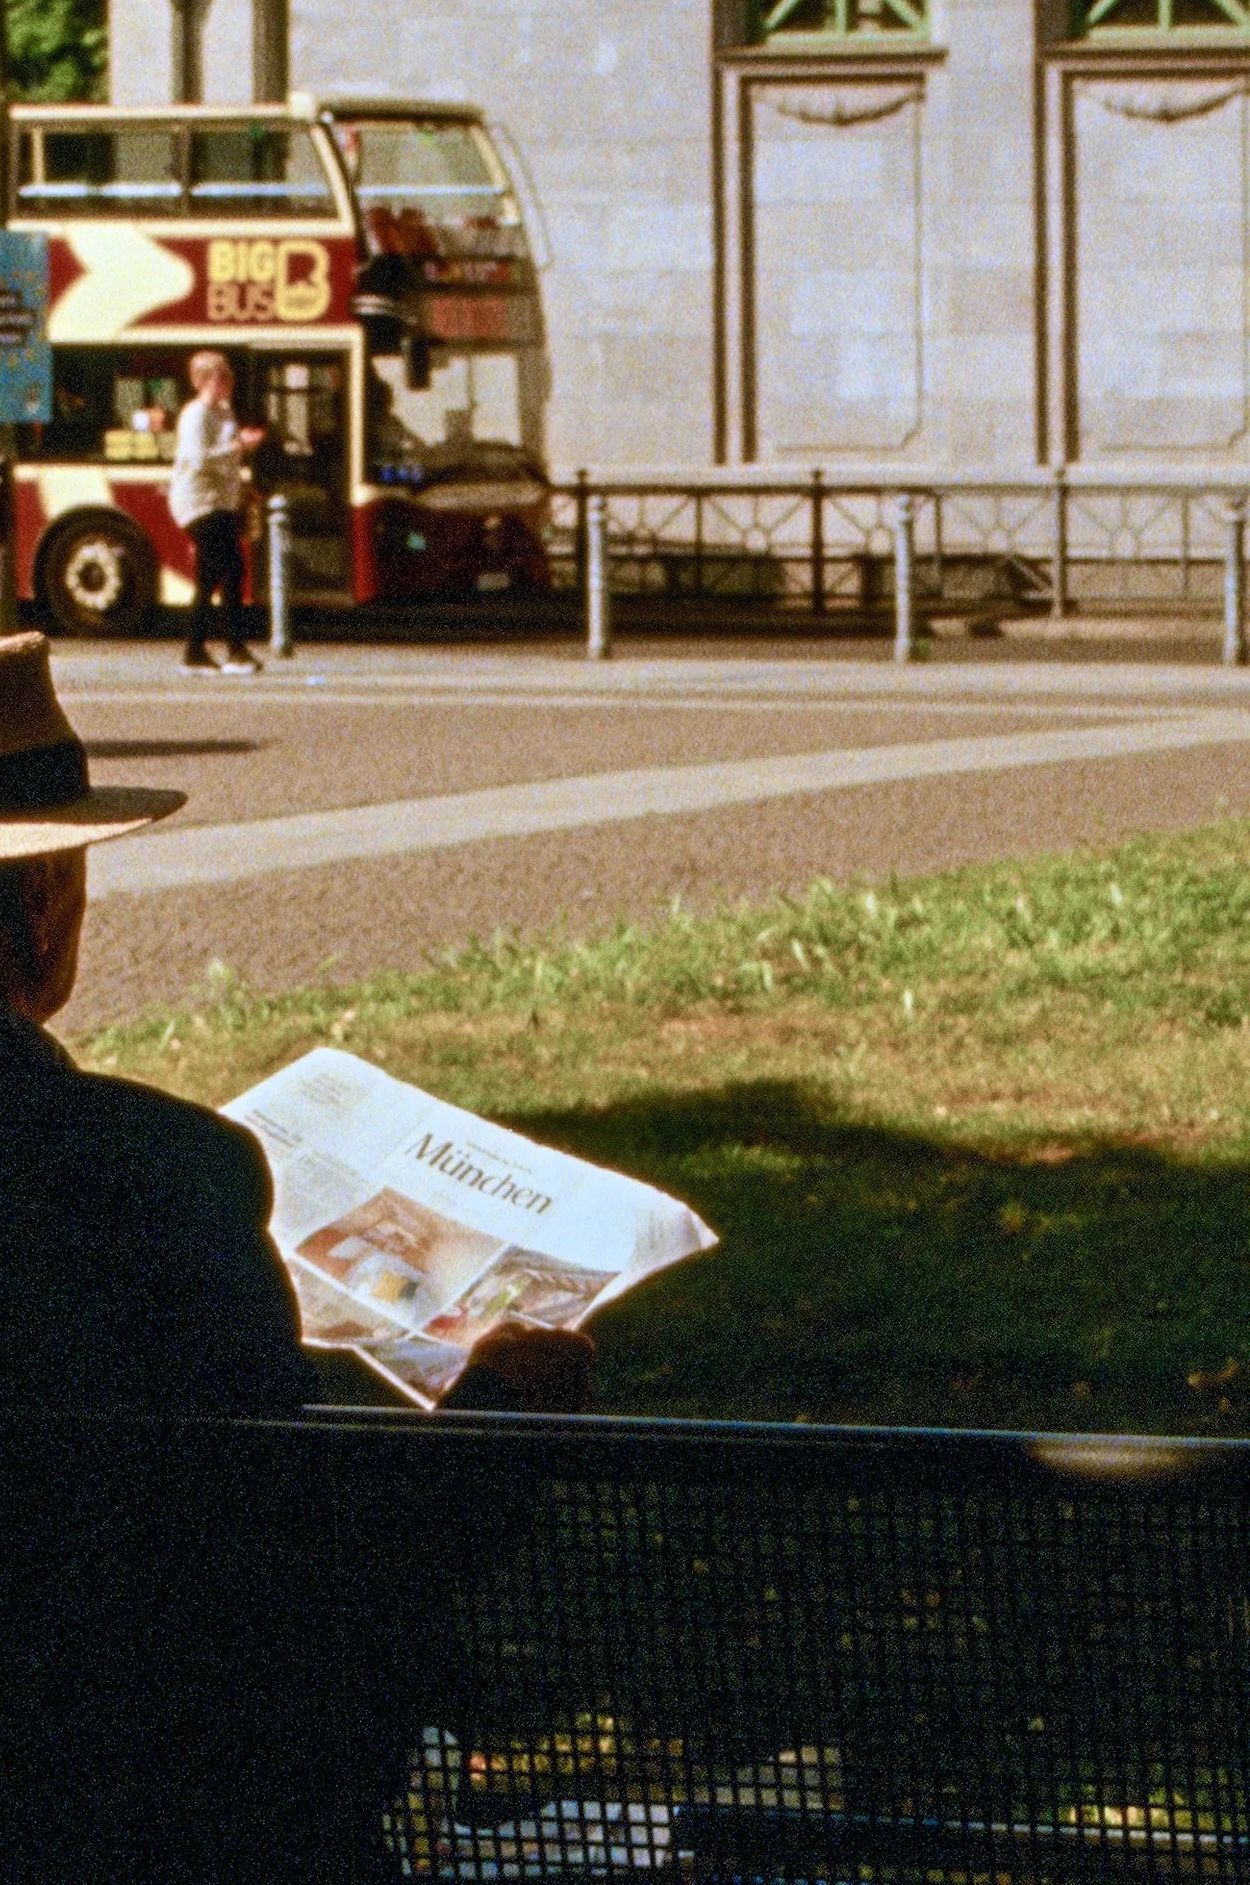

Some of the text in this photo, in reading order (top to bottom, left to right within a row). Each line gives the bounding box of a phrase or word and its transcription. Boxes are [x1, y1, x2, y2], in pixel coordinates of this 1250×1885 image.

[208, 240, 276, 282] BIG
[207, 282, 277, 322] BUS
[404, 1130, 554, 1216] München
